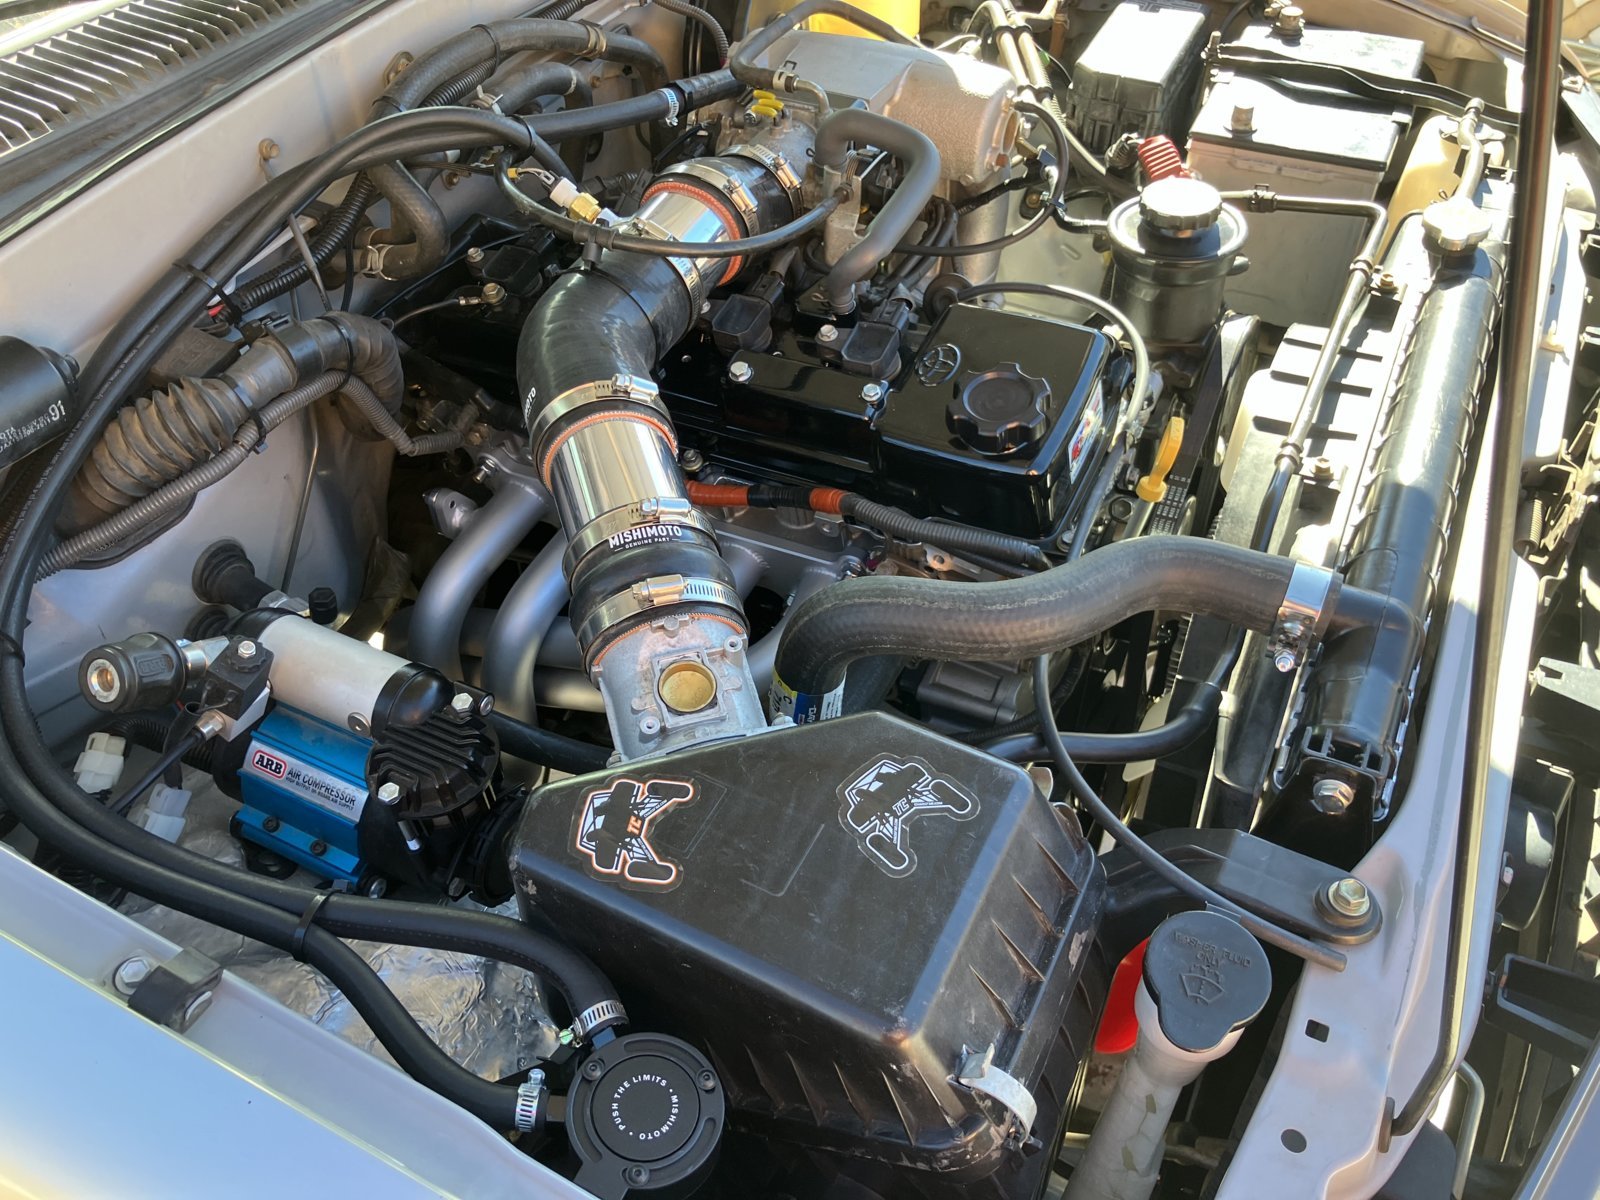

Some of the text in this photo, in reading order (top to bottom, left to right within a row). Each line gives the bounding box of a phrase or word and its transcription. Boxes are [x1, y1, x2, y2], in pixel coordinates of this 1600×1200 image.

[48, 400, 66, 421] 91
[608, 525, 682, 549] MISHIMOTO
[625, 539, 652, 549] GENUINE
[255, 754, 283, 775] ARB
[287, 768, 356, 806] AIR COMPRESSOR
[892, 797, 910, 816] TC
[611, 1074, 668, 1131] PUSH THE LIMITS
[638, 1094, 679, 1140] MISHIMOTO
